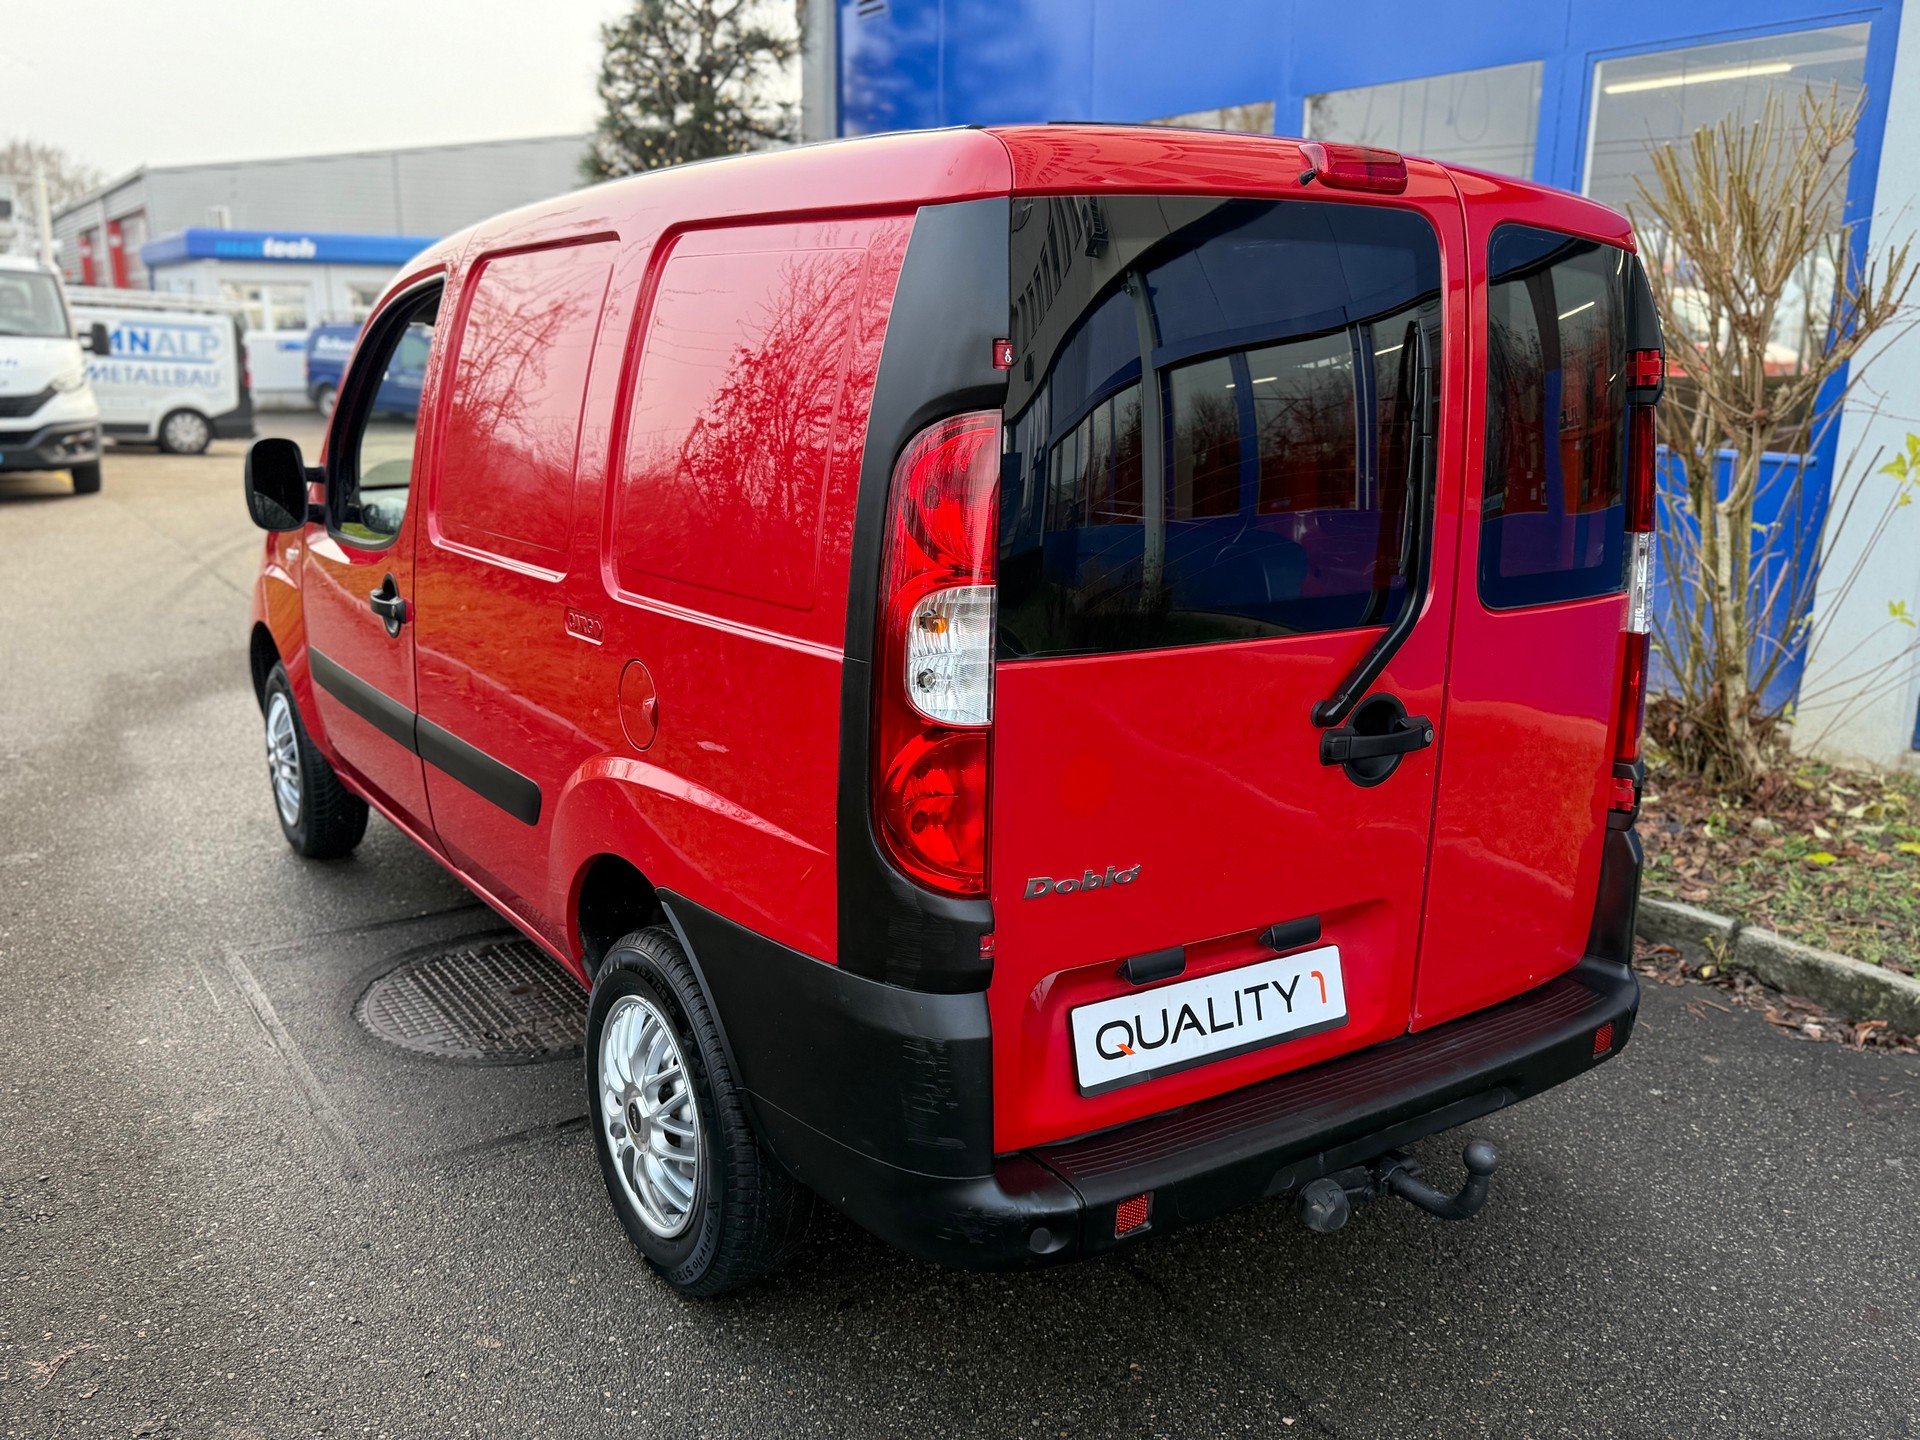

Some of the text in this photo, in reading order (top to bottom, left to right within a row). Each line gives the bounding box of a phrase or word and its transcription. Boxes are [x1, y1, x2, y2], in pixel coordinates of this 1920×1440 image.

[83, 366, 221, 388] METALLBAU
[1095, 969, 1328, 1061] QUALITY 1
